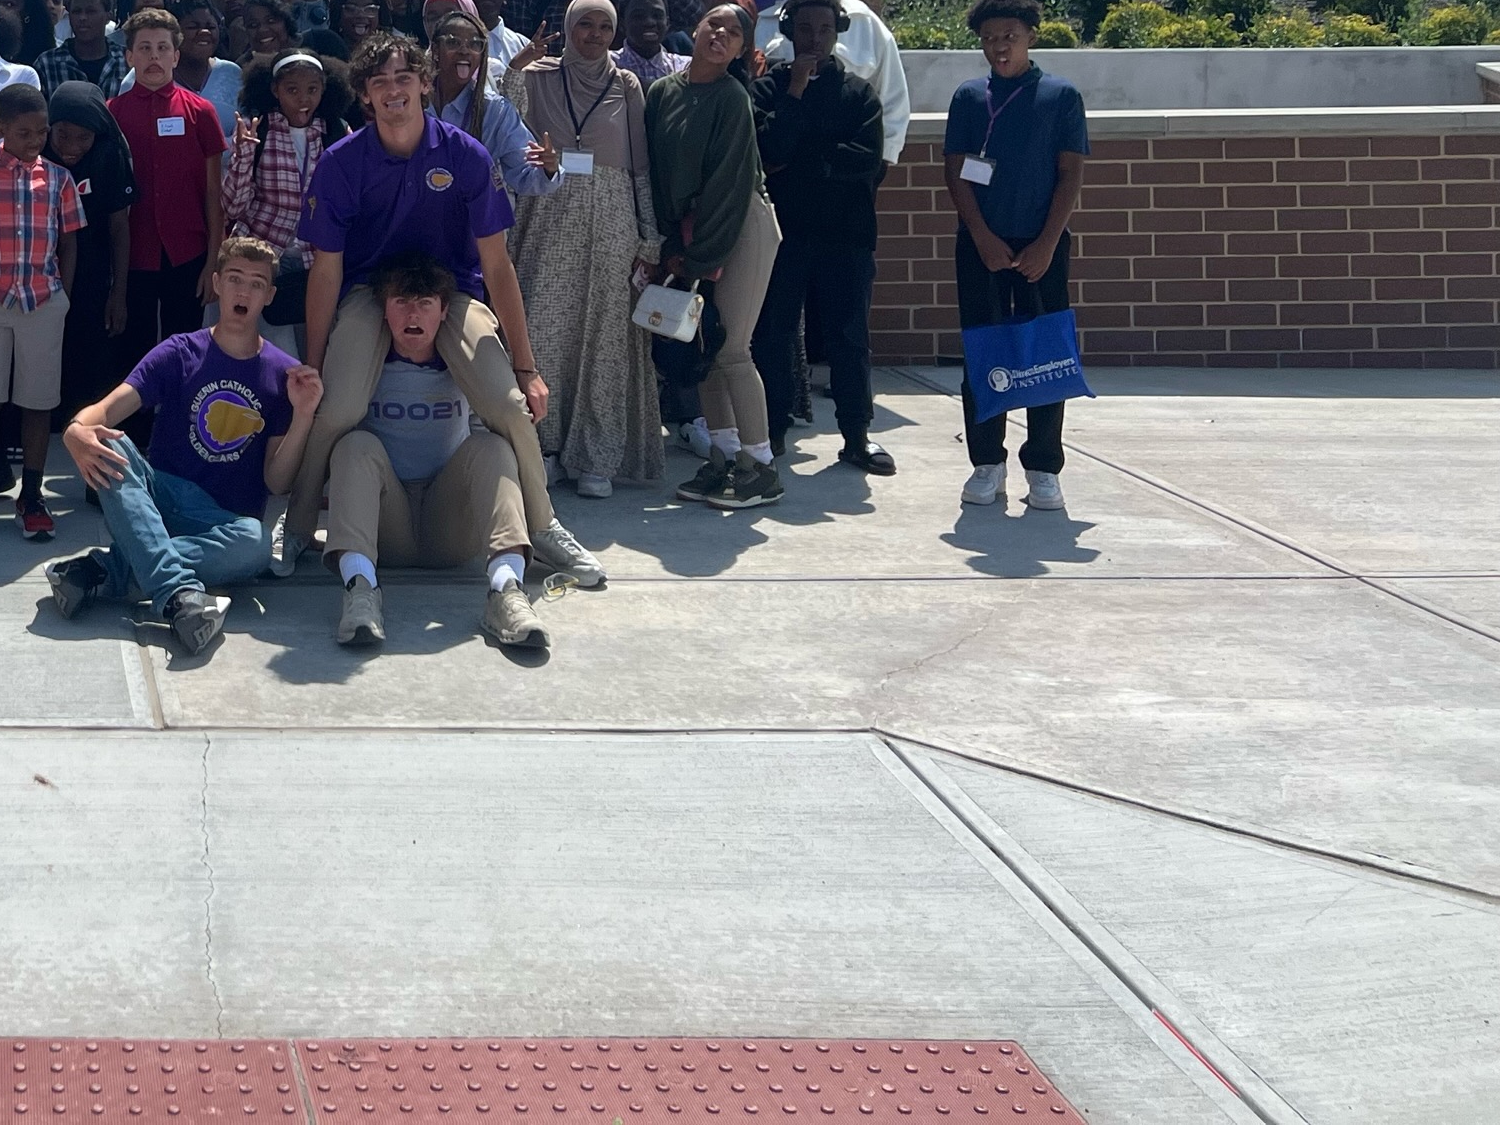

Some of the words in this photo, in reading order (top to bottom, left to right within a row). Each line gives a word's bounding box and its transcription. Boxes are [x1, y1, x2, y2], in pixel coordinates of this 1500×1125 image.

[1012, 366, 1079, 389] INSTITUTE
[191, 381, 219, 413] GUERIN
[220, 379, 262, 411] CATHOLIC
[371, 399, 463, 421] 10021
